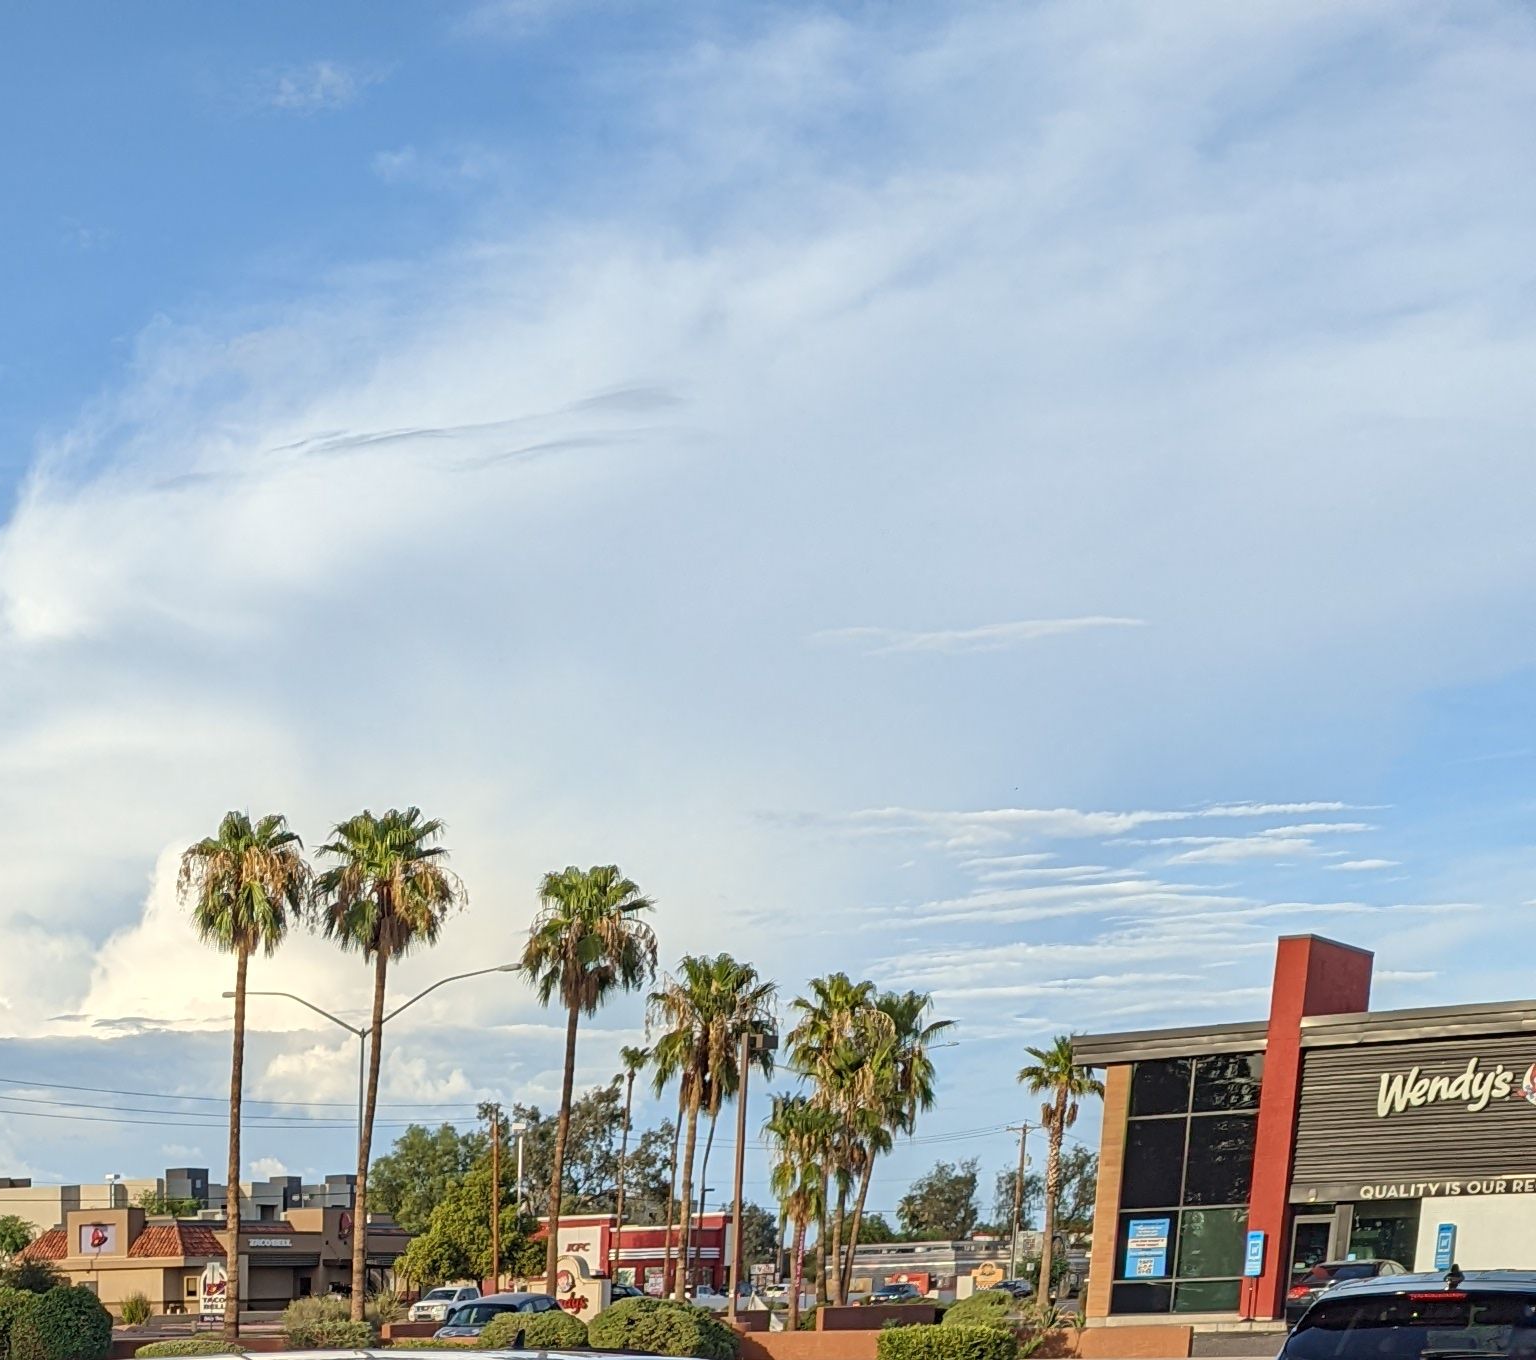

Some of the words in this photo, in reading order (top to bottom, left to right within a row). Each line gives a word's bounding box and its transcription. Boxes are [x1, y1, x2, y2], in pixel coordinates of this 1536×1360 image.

[1377, 1057, 1514, 1118] Wendy's
[1360, 1182, 1440, 1199] QUALITY
[1445, 1181, 1461, 1195] IS
[1467, 1180, 1507, 1194] OUR
[248, 1238, 271, 1247] TACO
[566, 1243, 591, 1252] KFC
